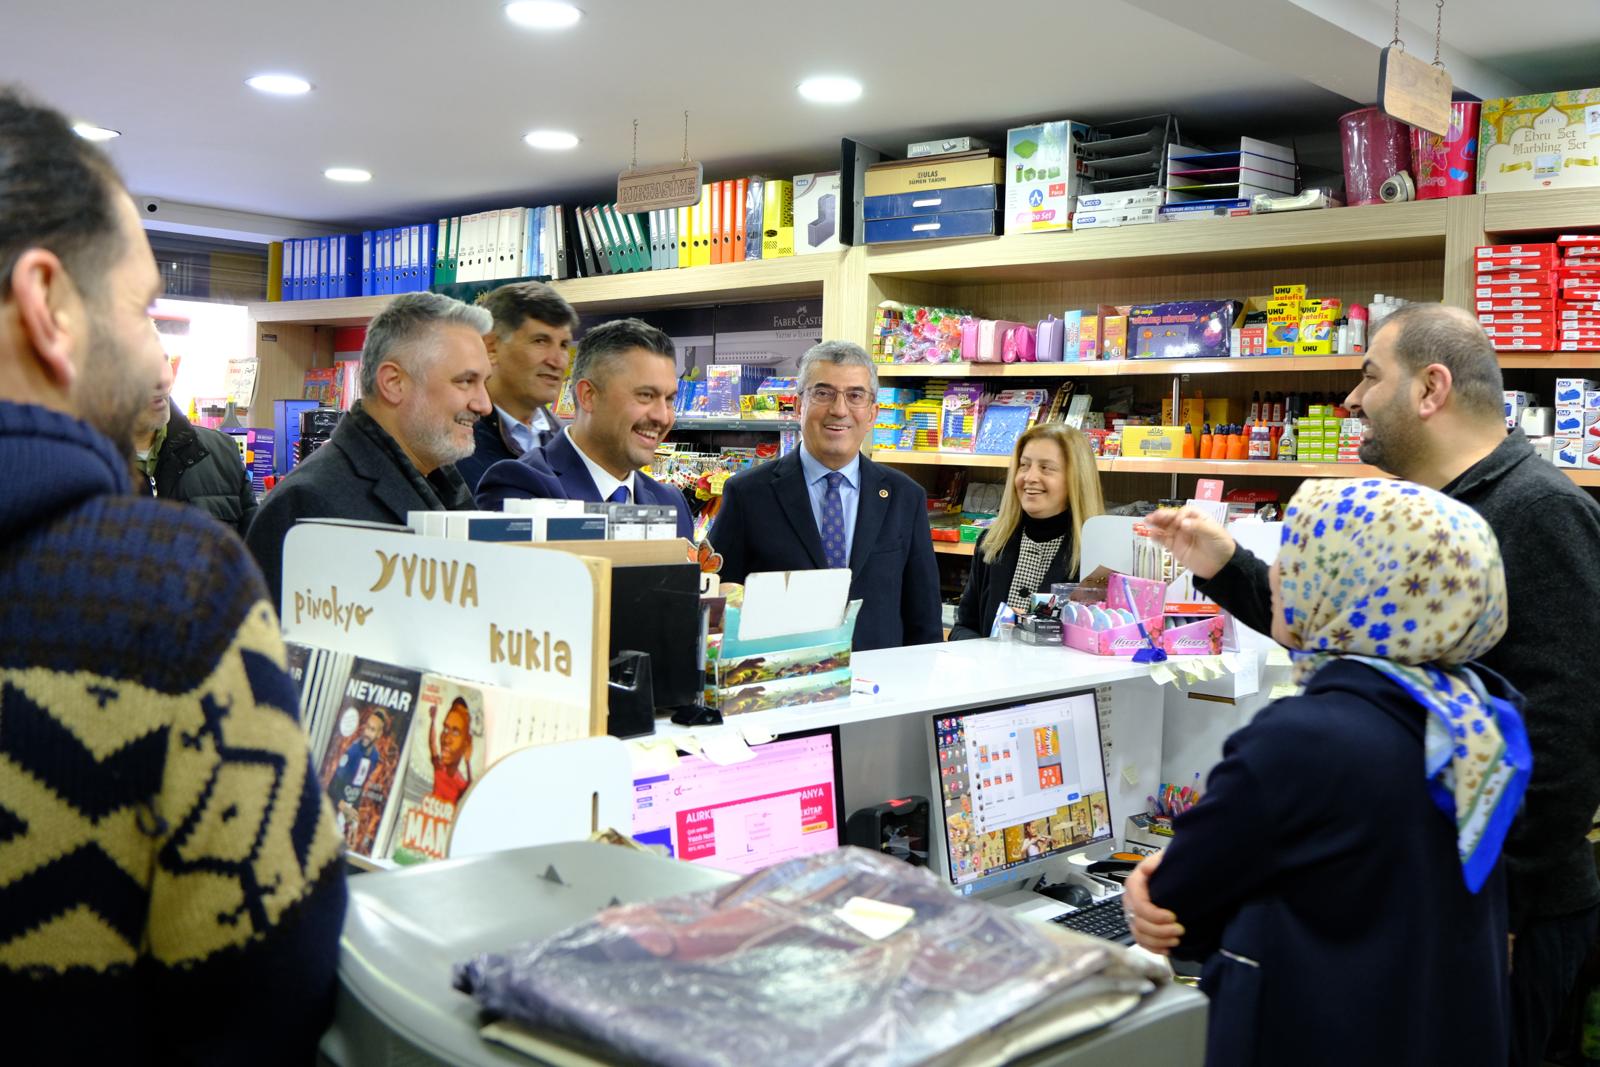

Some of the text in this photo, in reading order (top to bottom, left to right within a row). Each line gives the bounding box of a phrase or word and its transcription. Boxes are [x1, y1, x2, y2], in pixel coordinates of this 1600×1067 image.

[1524, 127, 1576, 142] Ebru Set
[1513, 139, 1586, 155] Marbling Set
[620, 174, 696, 203] KIRTASİYE
[1275, 287, 1291, 295] UHU
[1301, 306, 1317, 314] UHU
[1301, 313, 1328, 321] patafix
[1268, 315, 1297, 323] patafix
[400, 553, 479, 608] YUVA
[489, 622, 572, 677] kukla
[346, 678, 413, 713] NEYMAR
